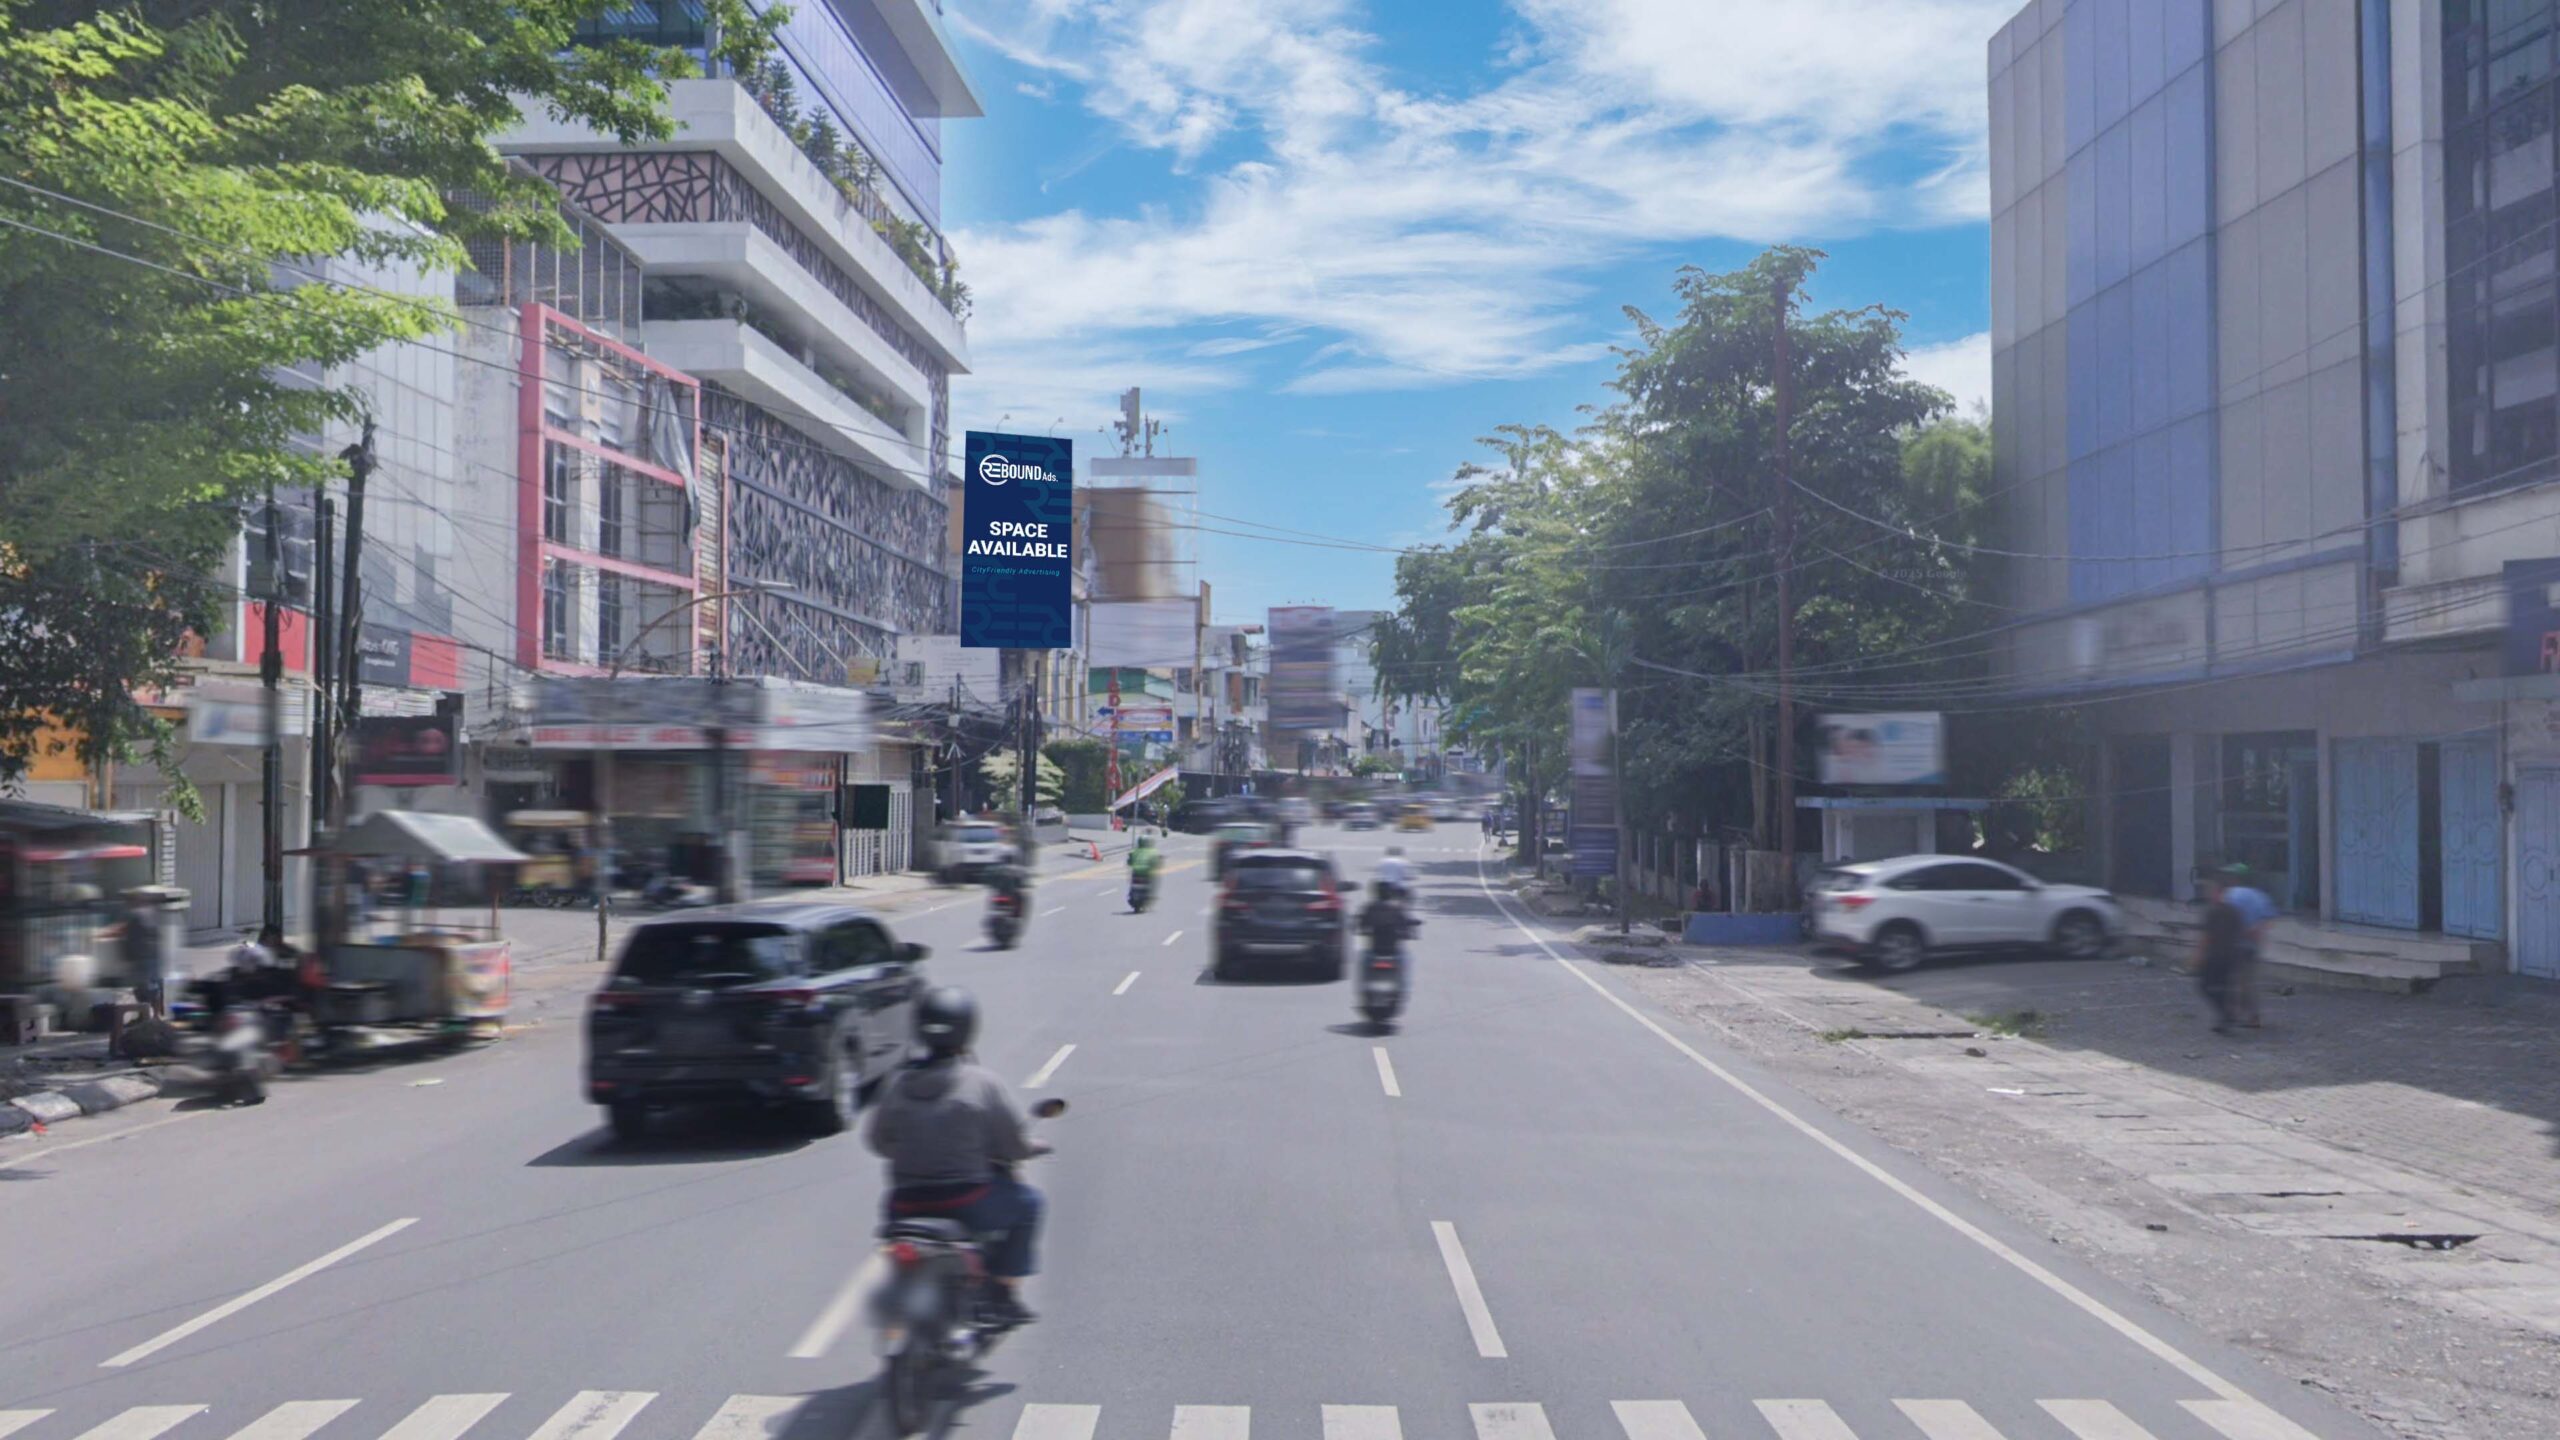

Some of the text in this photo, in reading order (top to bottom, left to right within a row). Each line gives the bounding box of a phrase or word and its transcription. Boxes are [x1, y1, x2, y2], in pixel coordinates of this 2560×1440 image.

[989, 521, 1048, 538] SPACE
[968, 540, 1068, 558] AVAILABLE
[1018, 567, 1060, 577] Advertising
